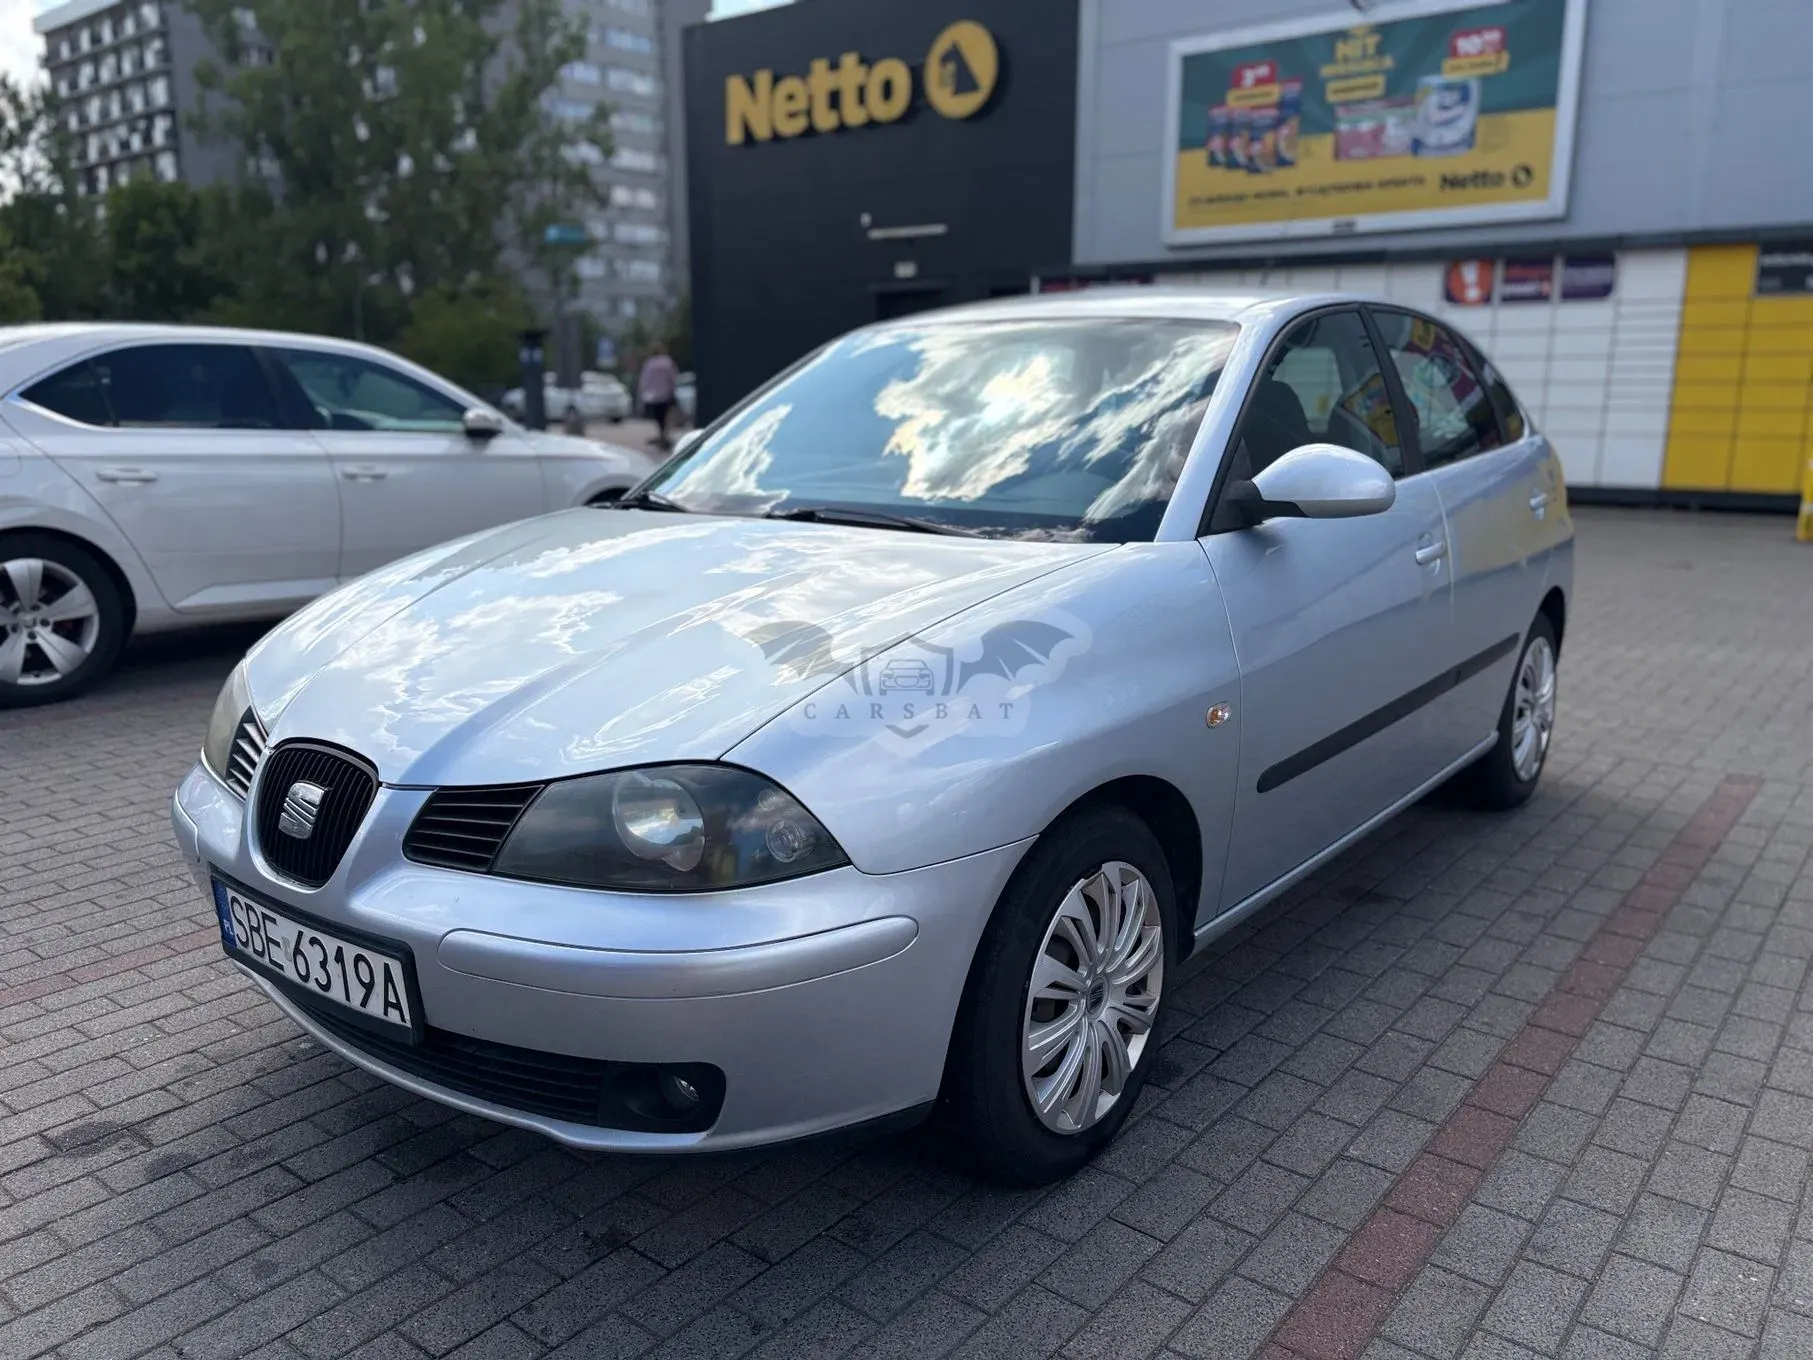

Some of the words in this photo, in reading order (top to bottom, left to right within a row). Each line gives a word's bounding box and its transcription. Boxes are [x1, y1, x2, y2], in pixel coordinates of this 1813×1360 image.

[725, 51, 912, 146] Netto
[1440, 170, 1506, 192] Netto
[230, 895, 285, 973] SBE
[292, 930, 407, 1024] 6319A
